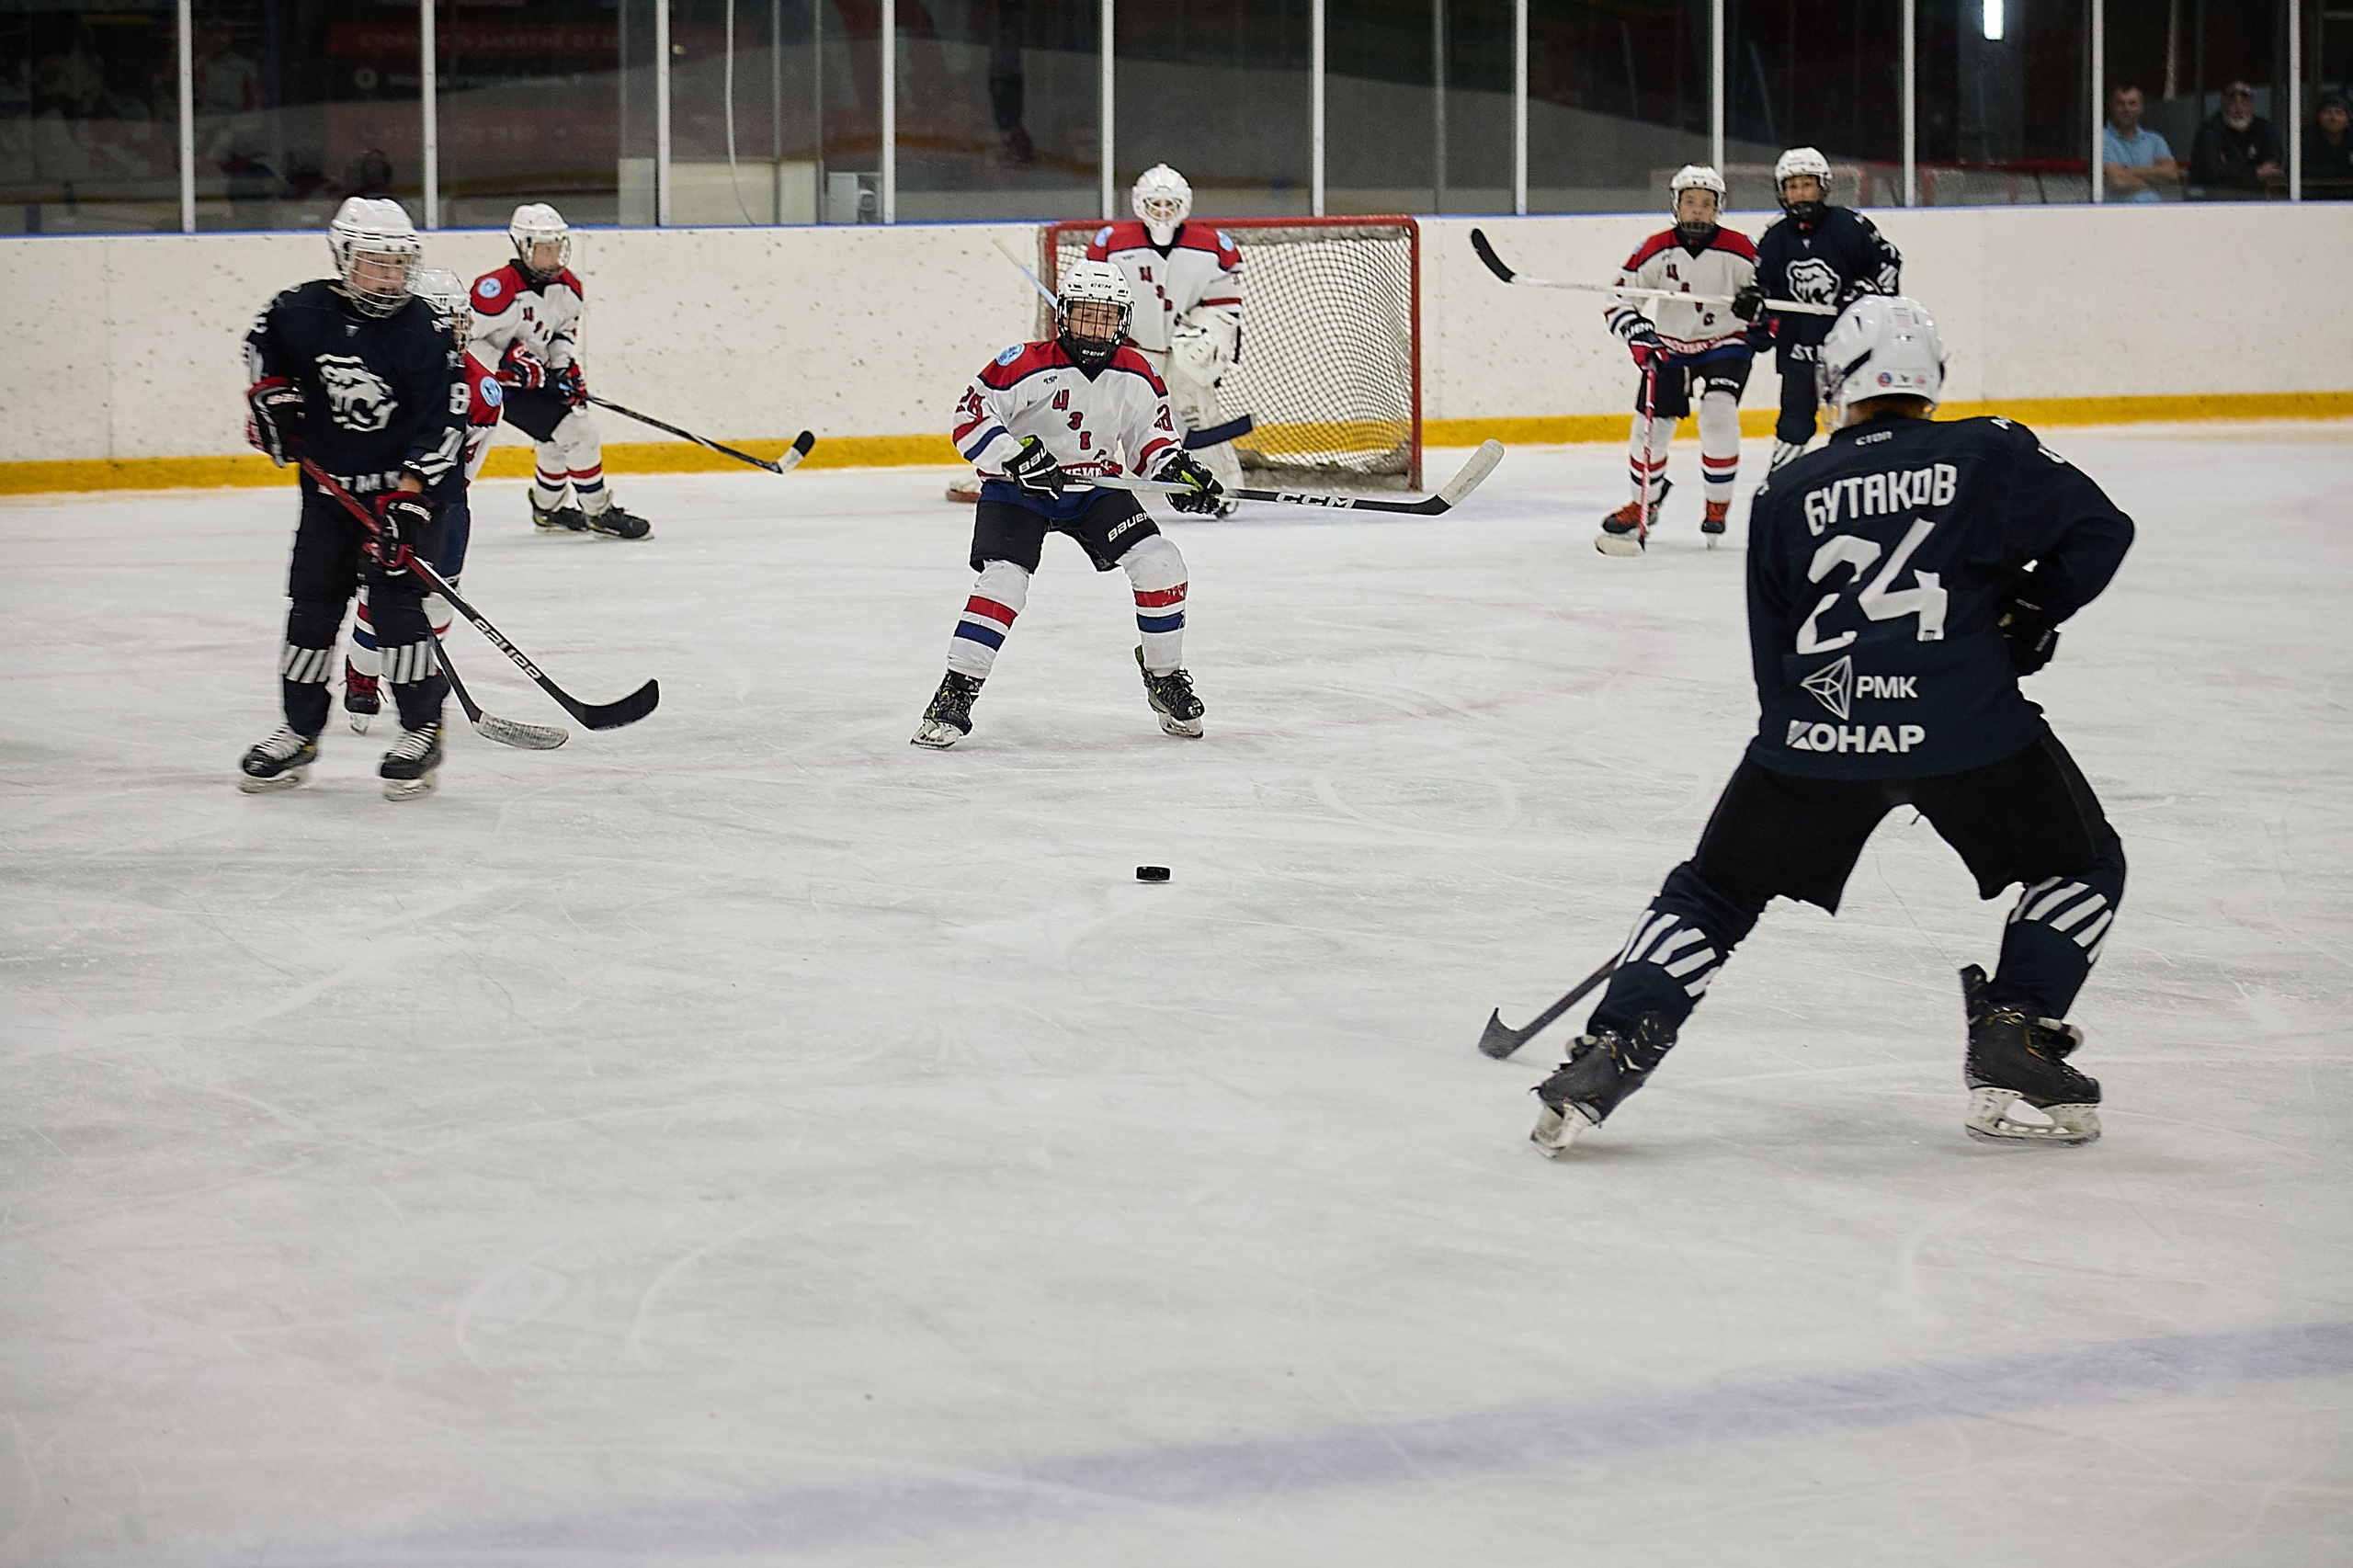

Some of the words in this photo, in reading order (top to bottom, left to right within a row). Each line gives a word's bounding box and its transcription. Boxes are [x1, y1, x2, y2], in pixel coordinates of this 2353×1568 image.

[1276, 493, 1356, 509] CCM
[1803, 462, 1958, 537] БУТАКОВ
[1796, 517, 1949, 655] 24
